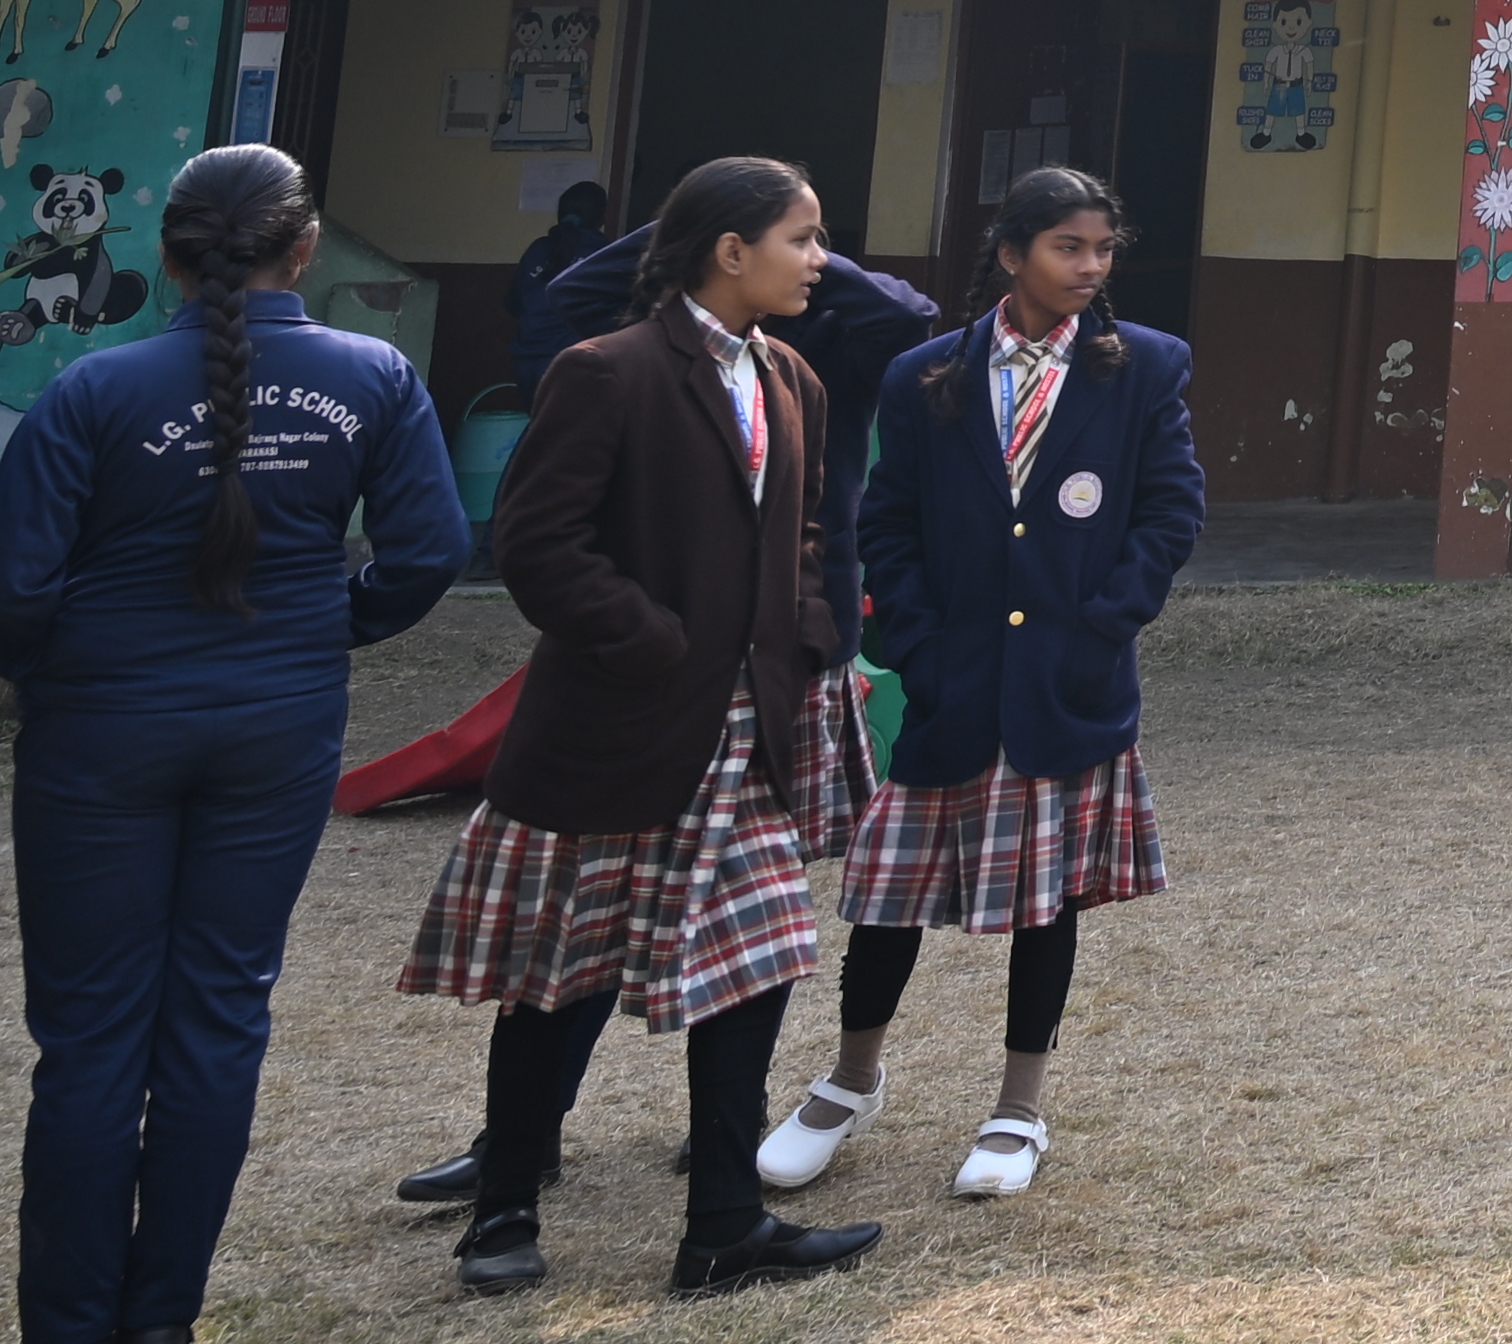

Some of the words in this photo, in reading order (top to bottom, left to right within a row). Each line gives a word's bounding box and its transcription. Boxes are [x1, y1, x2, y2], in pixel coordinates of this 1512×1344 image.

[142, 420, 192, 456] L.G.
[287, 387, 364, 443] SCHOOL
[303, 432, 330, 443] Colony
[1012, 423, 1027, 446] PUBLIC
[1024, 398, 1041, 423] SCHOOL
